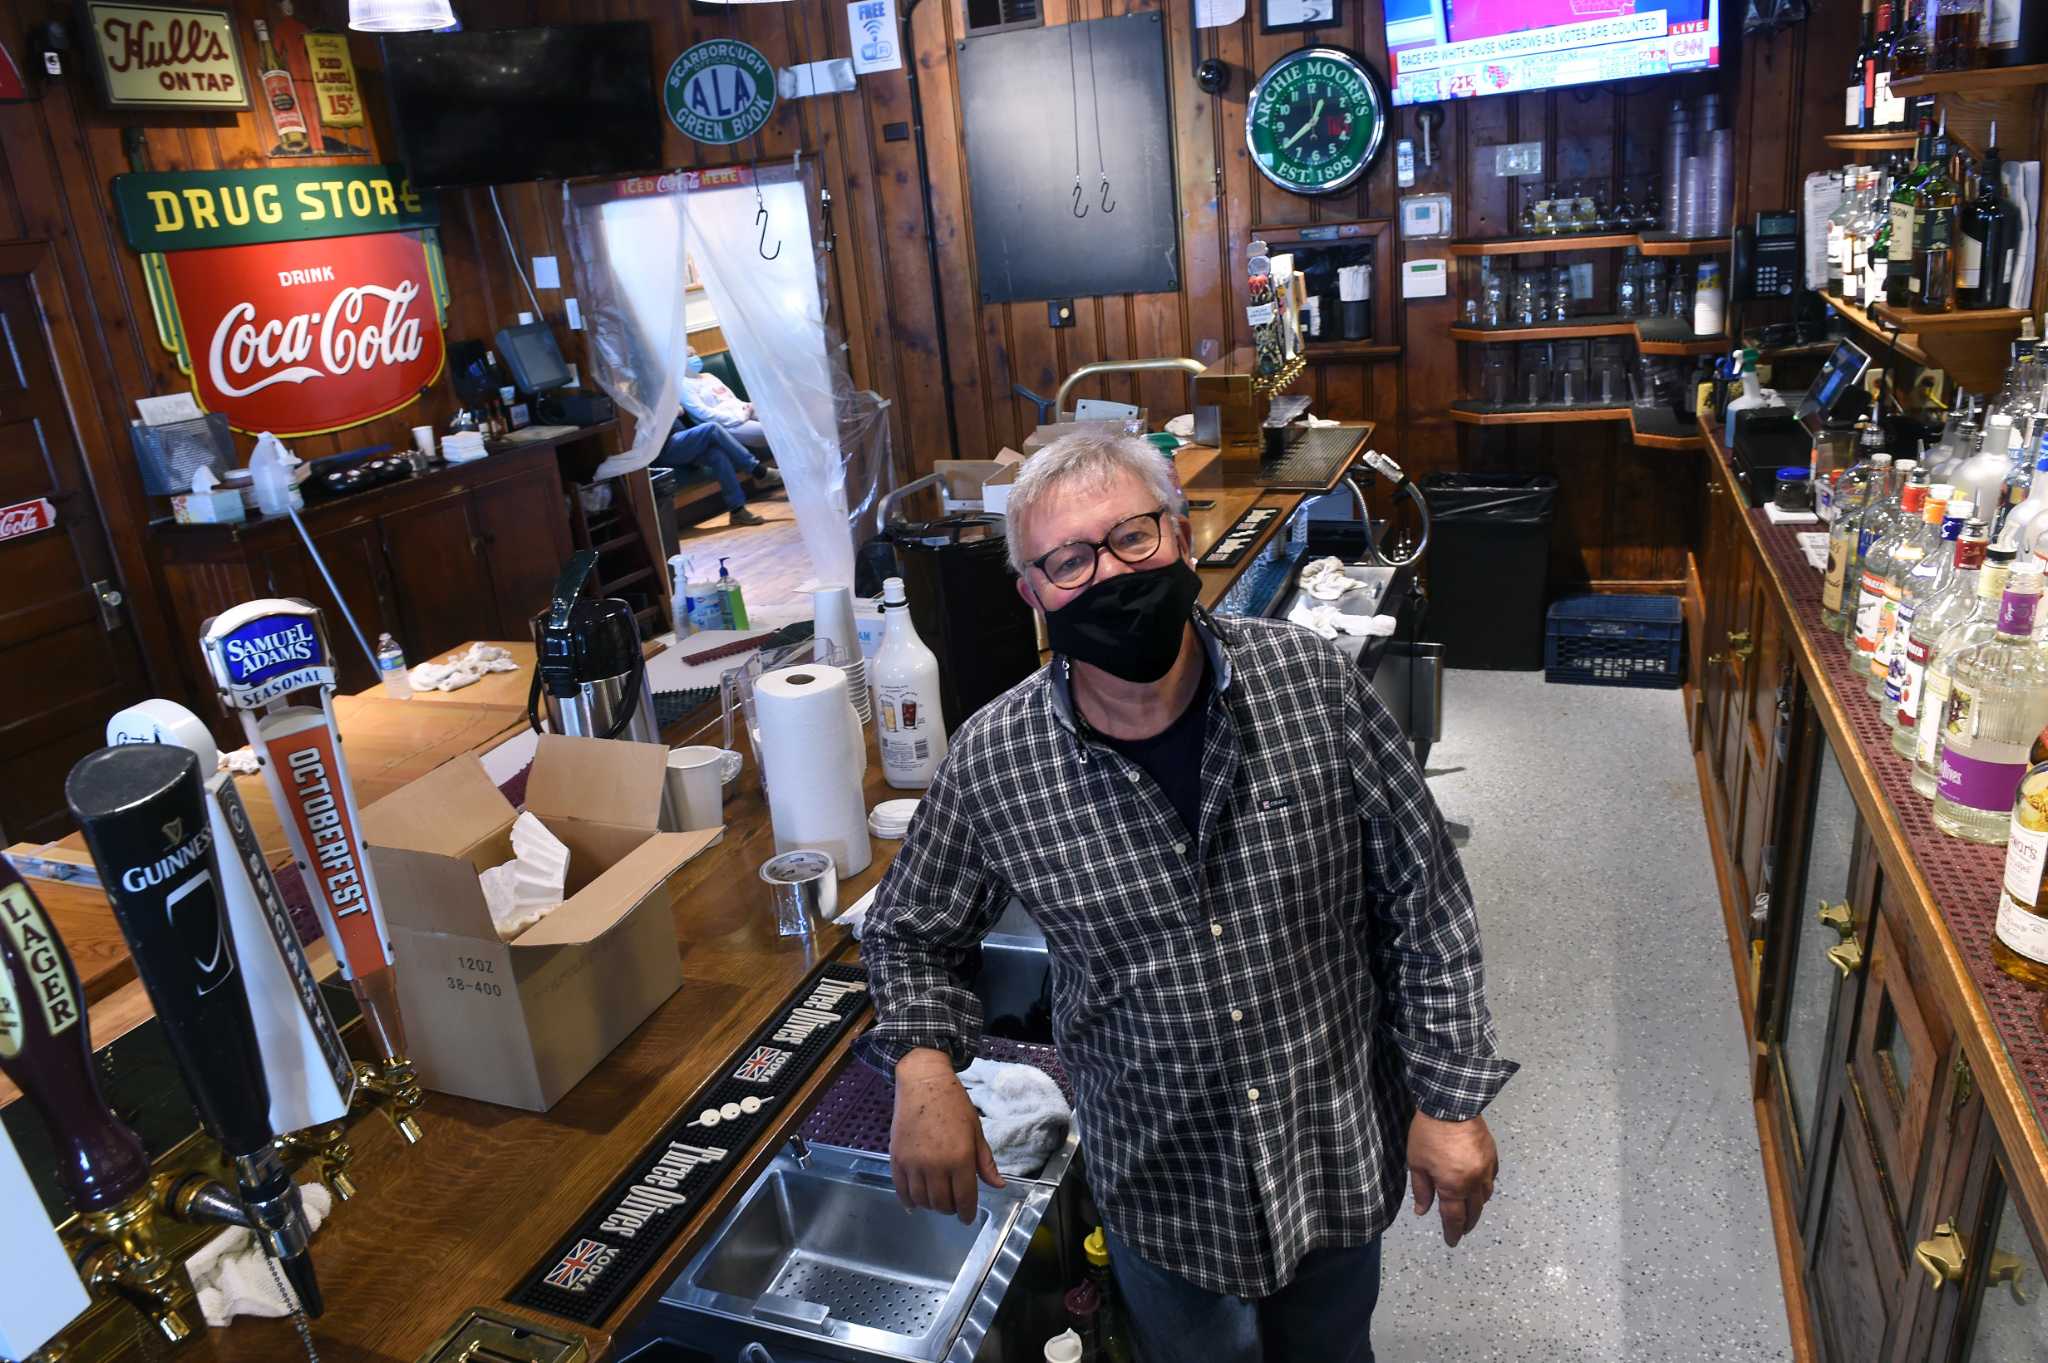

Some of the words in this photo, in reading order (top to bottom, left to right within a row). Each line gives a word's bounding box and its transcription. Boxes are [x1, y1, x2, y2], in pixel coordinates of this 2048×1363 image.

[858, 2, 885, 20] FREE
[1401, 53, 1421, 66] RACE
[1423, 50, 1439, 63] FOR
[1442, 46, 1466, 60] WHITE
[1469, 41, 1496, 56] HOUSE
[1498, 35, 1542, 51] NARROWS
[1545, 32, 1555, 45] AS
[1560, 27, 1587, 44] VOTES
[1591, 24, 1608, 38] ARE
[1612, 17, 1658, 36] COUNTED
[1673, 21, 1705, 35] LIVE
[103, 17, 229, 73] Hull's
[1673, 38, 1704, 56] CNN
[315, 71, 352, 84] LABEL
[670, 44, 766, 88] SCARBOROUGH
[159, 71, 191, 90] ON
[192, 72, 235, 91] TAP
[692, 65, 751, 117] ALA
[1257, 64, 1302, 129] ARCHIE
[1306, 61, 1369, 117] MOORE'S
[1307, 82, 1317, 94] 12
[1280, 104, 1290, 116] 10
[1291, 90, 1298, 102] 11
[1339, 97, 1348, 108] 2
[675, 108, 724, 139] GREEN
[732, 94, 770, 137] BOOK
[1277, 121, 1285, 132] 9
[1344, 113, 1352, 124] 3
[1328, 143, 1337, 154] 5
[1339, 130, 1349, 141] 4
[1296, 147, 1303, 158] 7
[1312, 150, 1320, 161] 6
[623, 179, 653, 194] ICED
[702, 172, 737, 185] HERE
[1277, 162, 1310, 183] EST.
[1317, 155, 1353, 182] 1898
[146, 184, 283, 232] DRUG
[296, 179, 424, 221] STORE
[278, 266, 335, 287] DRINK
[209, 280, 423, 397] Coca-Cola
[227, 623, 314, 662] SAMUEL
[241, 641, 313, 678] ADAMS
[242, 669, 321, 706] SEASONAL
[287, 747, 368, 918] OCTOBERFEST
[1, 898, 75, 1028] LAGER
[447, 976, 502, 997] 38-400
[771, 1006, 842, 1046] Olives
[757, 1050, 793, 1084] VODKA
[643, 1140, 728, 1191] Three
[599, 1183, 687, 1239] Olives
[570, 1247, 620, 1294] VODKA
